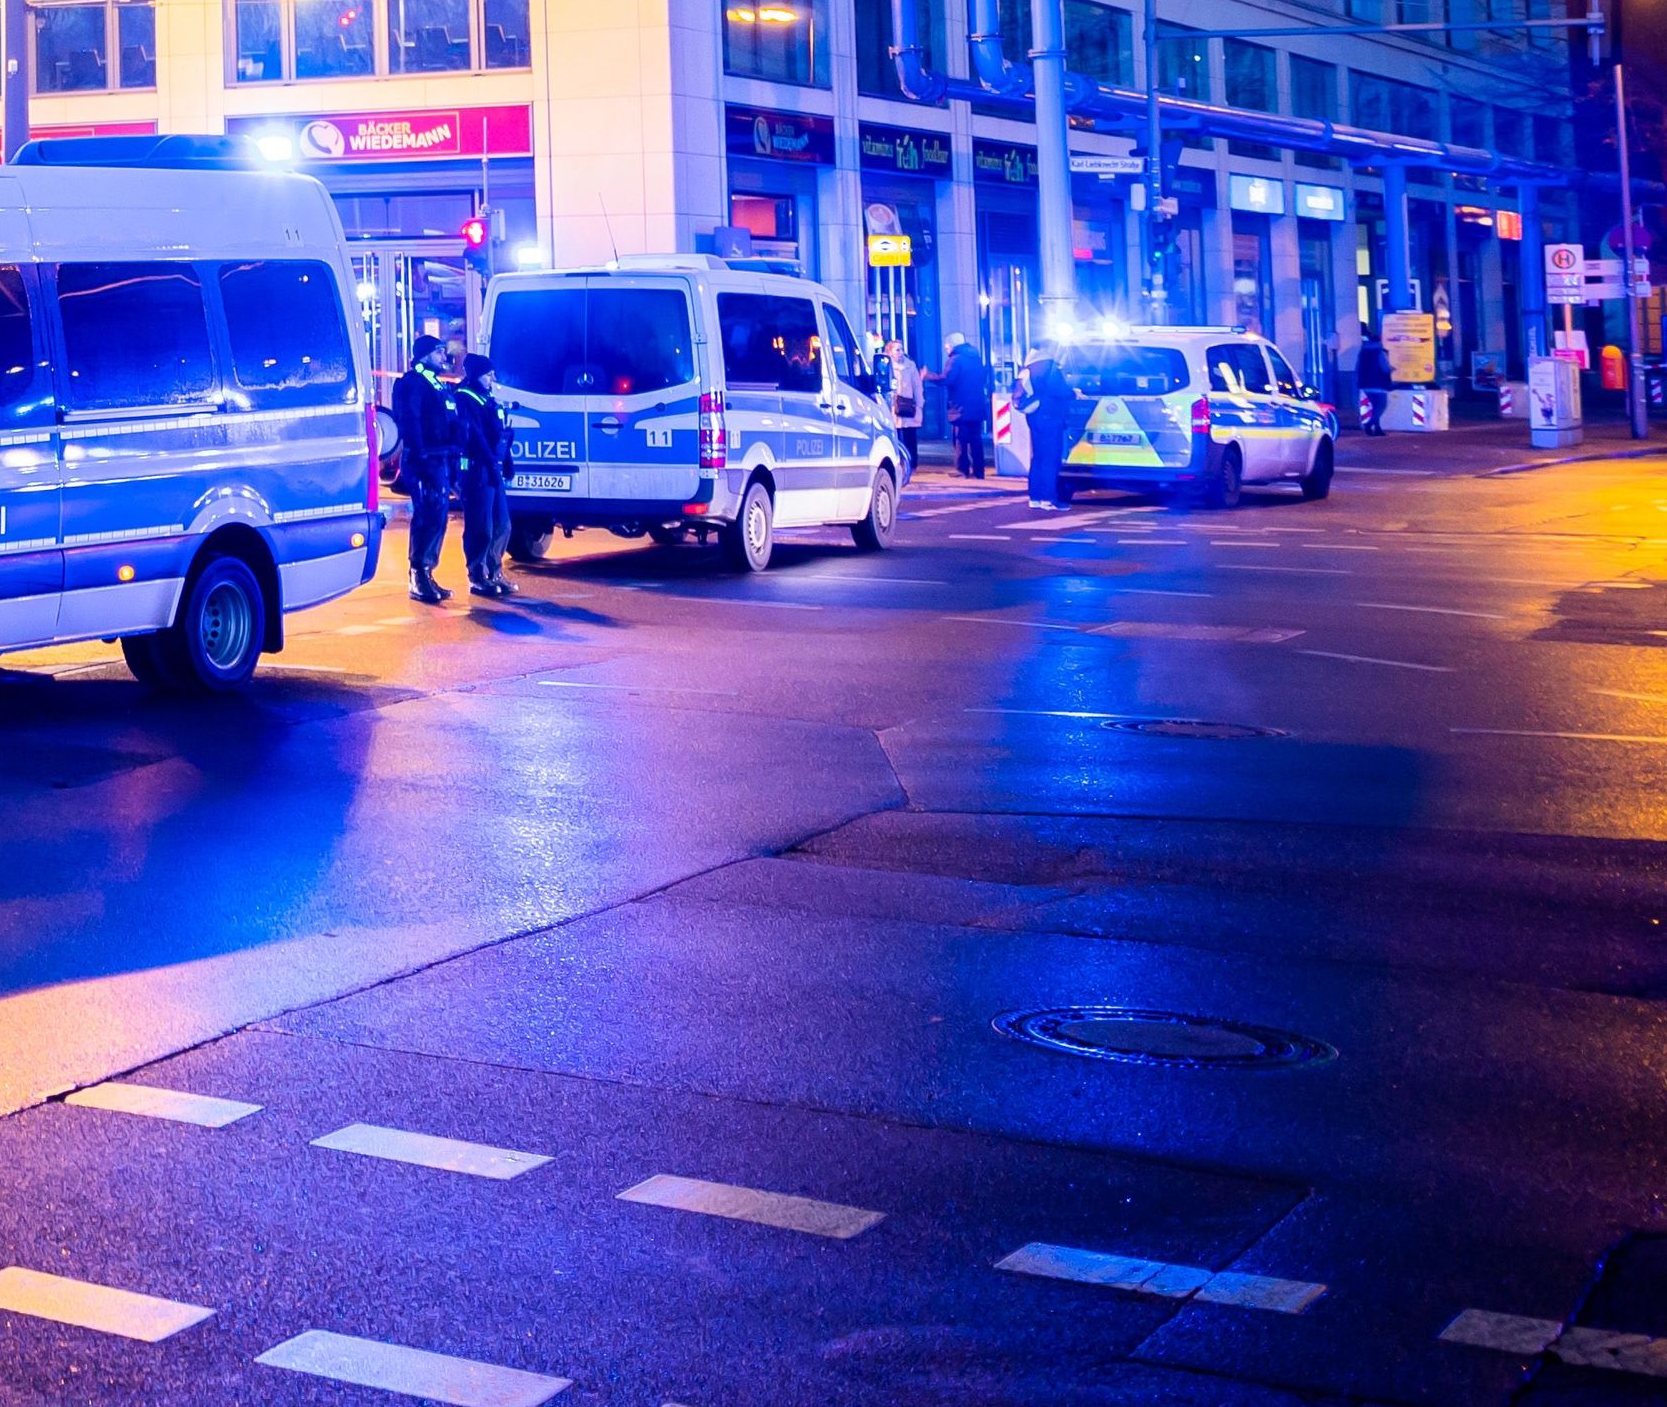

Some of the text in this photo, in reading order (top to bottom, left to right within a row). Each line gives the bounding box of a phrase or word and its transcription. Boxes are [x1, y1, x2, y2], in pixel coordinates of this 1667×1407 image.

[357, 121, 411, 136] BÄCKER
[349, 124, 452, 151] WIEDEMANN
[649, 430, 669, 445] 11
[510, 441, 576, 459] OLIZEI
[796, 439, 824, 456] POLIZEI
[516, 475, 564, 489] B 31626
